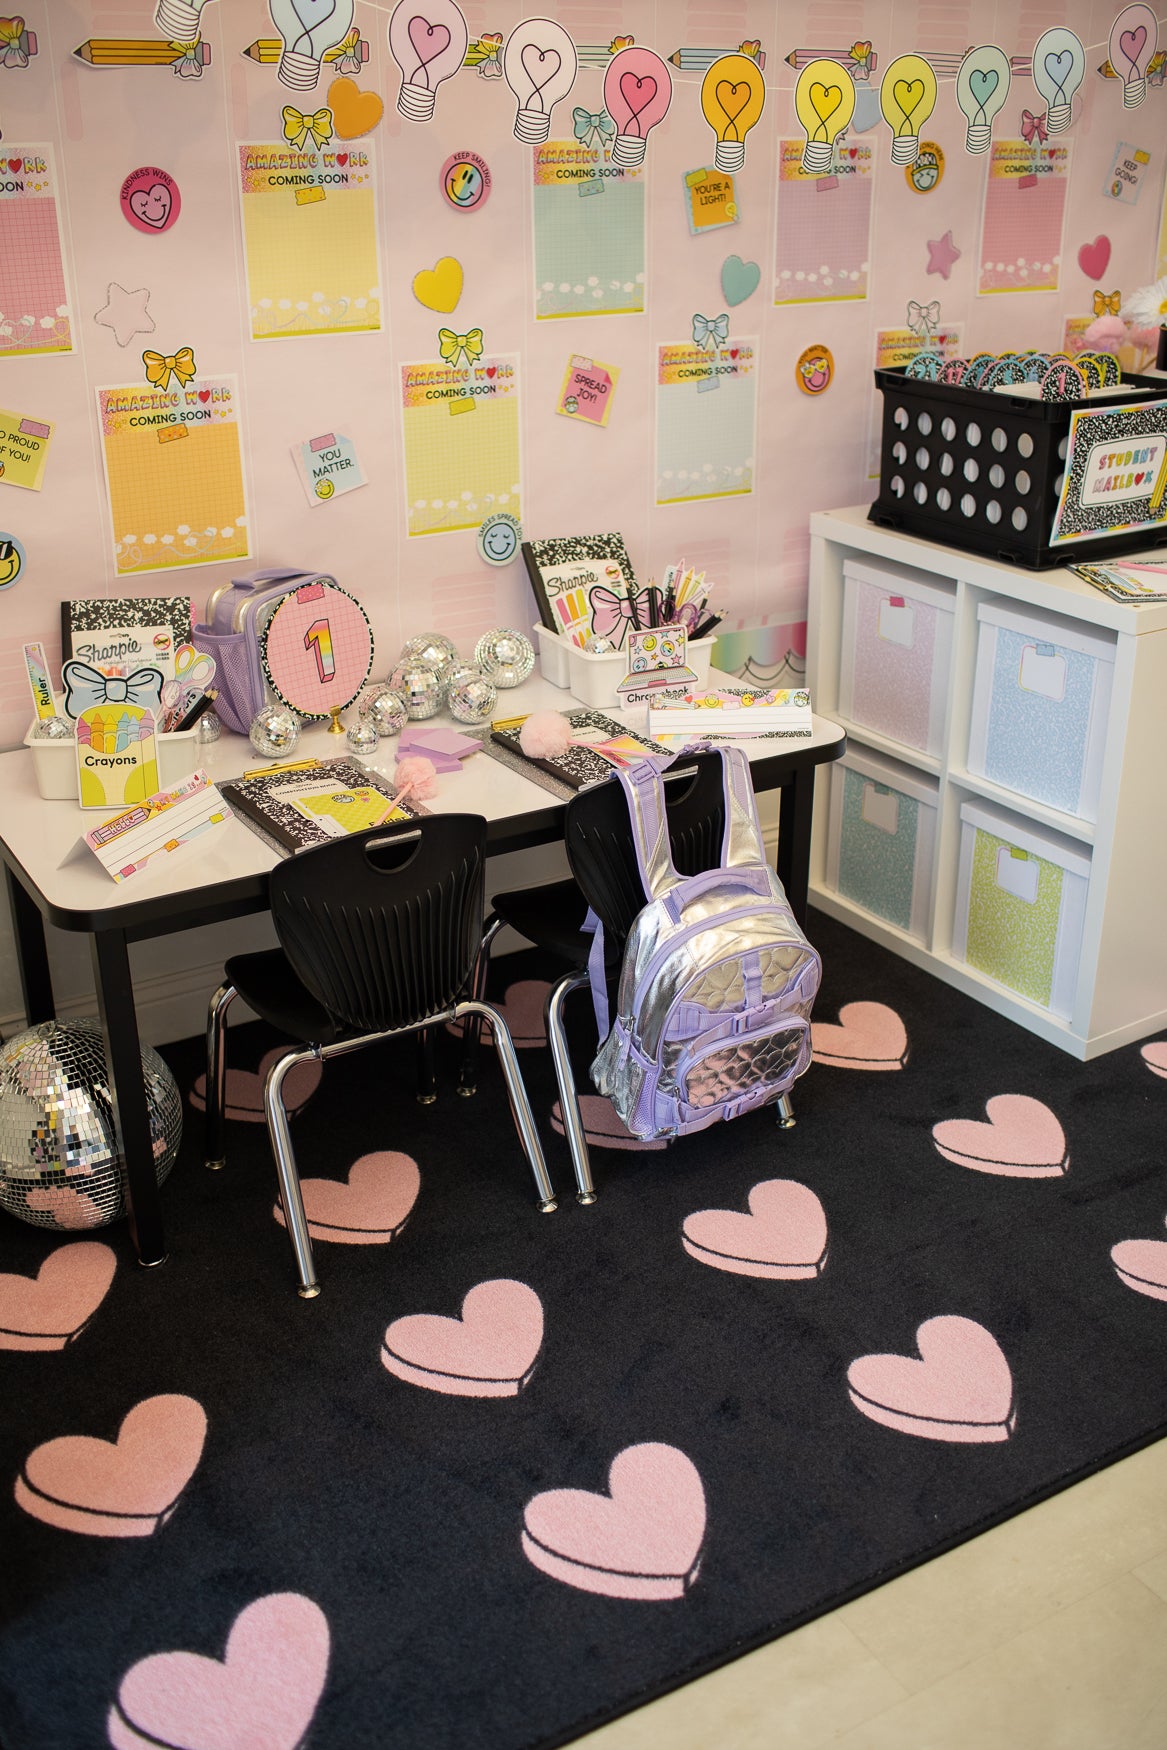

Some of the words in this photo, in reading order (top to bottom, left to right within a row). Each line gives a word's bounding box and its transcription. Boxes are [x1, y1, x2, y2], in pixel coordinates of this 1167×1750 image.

[245, 153, 318, 170] AMAZING
[454, 152, 470, 161] KEEP
[556, 169, 596, 179] COMING
[598, 168, 624, 178] SOON
[833, 165, 857, 175] SOON
[1034, 163, 1054, 173] SOON
[1122, 159, 1138, 177] KEEP
[121, 168, 150, 200] KINDNESS
[152, 169, 172, 186] WINS
[267, 175, 314, 186] COMING
[317, 173, 349, 185] SOON
[724, 181, 731, 191] A
[678, 367, 712, 378] COMING
[715, 365, 738, 375] SOON
[574, 373, 607, 394] SPREAD
[1057, 372, 1066, 395] 1
[425, 388, 466, 400] COMING
[469, 385, 496, 396] SOON
[105, 393, 180, 414] AMAZING
[129, 413, 177, 426] COMING
[180, 409, 211, 422] SOON
[8, 433, 40, 451] PROUD
[9, 449, 31, 463] YOU!
[319, 448, 341, 463] YOU
[1098, 446, 1158, 470] STUDENT
[497, 513, 519, 526] SPREAD
[547, 570, 598, 597] Sharpie
[76, 637, 142, 663] Sharpie
[304, 618, 335, 684] 1
[38, 677, 51, 706] Ruler
[84, 756, 137, 768] Crayons
